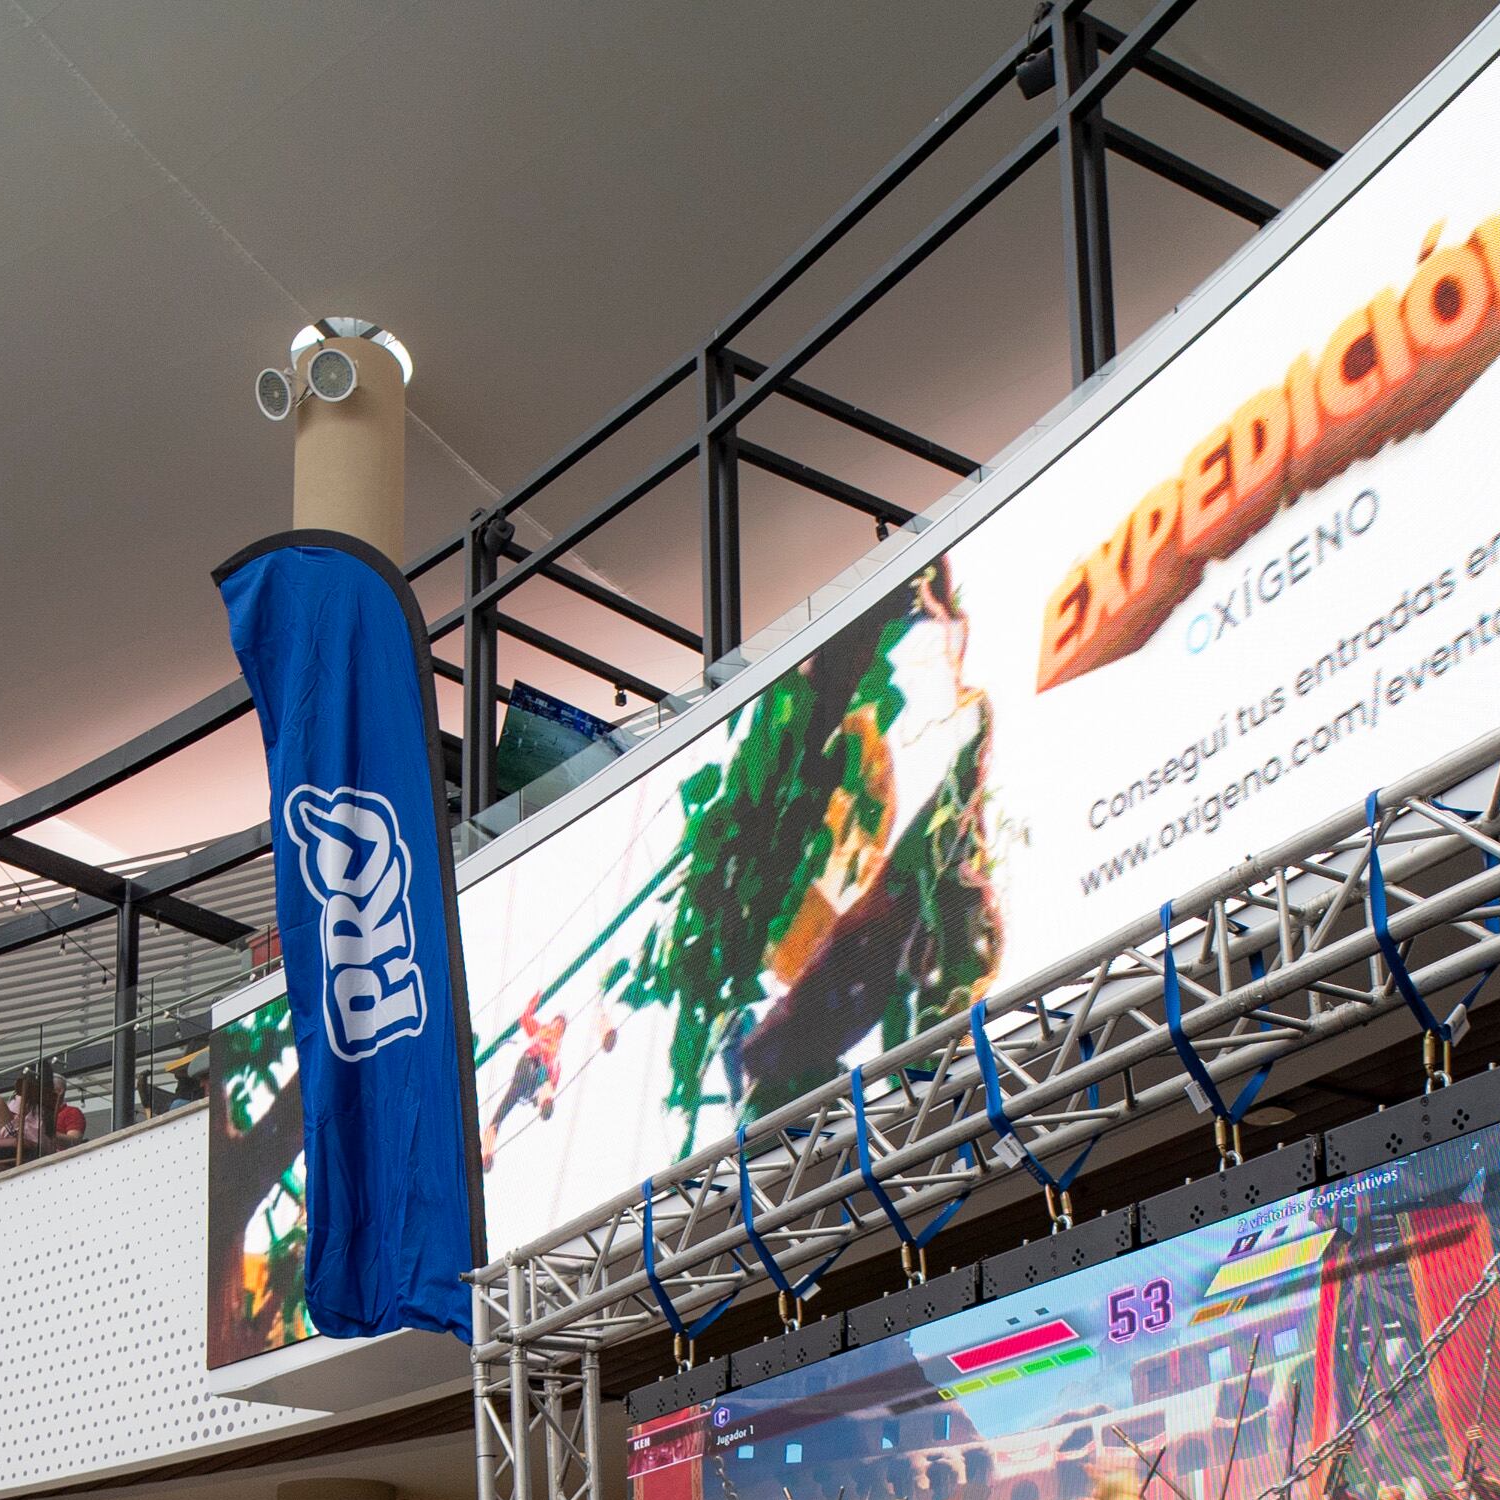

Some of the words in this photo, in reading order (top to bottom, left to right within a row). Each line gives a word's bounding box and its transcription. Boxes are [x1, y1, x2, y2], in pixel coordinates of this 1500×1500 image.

[1185, 487, 1380, 655] OXÍGENO
[1235, 685, 1287, 736] tus
[1294, 567, 1457, 699] entradas
[296, 798, 419, 1045] PRO
[1237, 1217, 1248, 1234] 2
[1250, 1201, 1307, 1230] victorias
[1309, 1168, 1399, 1209] consecutivas
[1107, 1275, 1174, 1344] 53
[633, 1437, 651, 1451] KEN
[716, 1428, 747, 1446] Jugador
